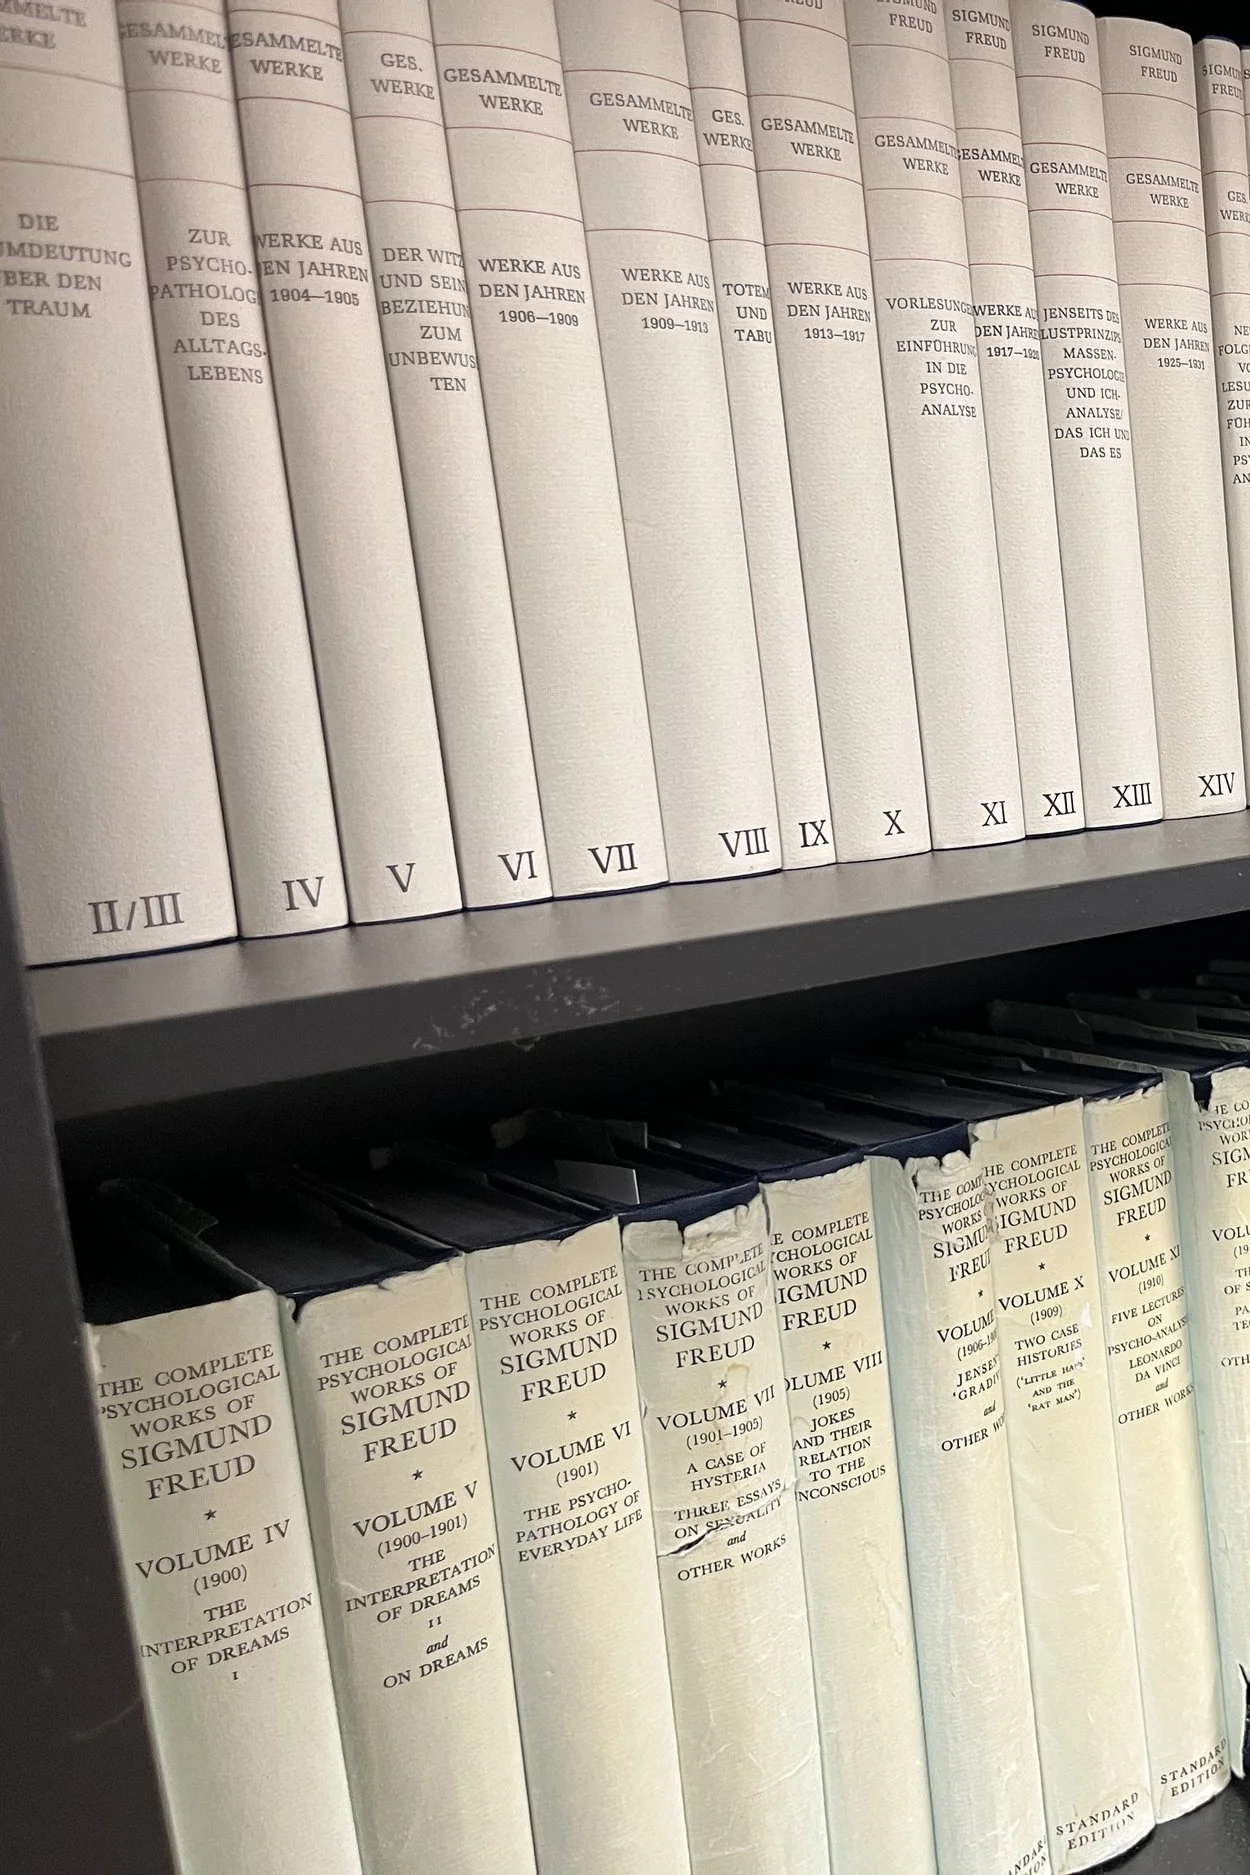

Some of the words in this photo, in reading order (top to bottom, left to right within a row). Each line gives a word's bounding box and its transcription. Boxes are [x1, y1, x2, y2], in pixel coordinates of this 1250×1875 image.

[889, 13, 933, 34] FREUD
[1032, 24, 1090, 46] SIGMUND
[148, 49, 223, 75] WERKE
[381, 53, 423, 72] GES.
[1044, 45, 1086, 64] FREUD
[1129, 45, 1182, 65] SIGMUND
[444, 68, 562, 96] GESAMMELTE
[1141, 66, 1178, 83] FREUD
[479, 94, 543, 116] WERKE
[590, 92, 693, 122] GESAMMELTE
[712, 109, 744, 126] GES.
[622, 118, 679, 140] WERKE
[761, 118, 854, 144] GESAMMELTE
[791, 142, 842, 162] WERKE
[1126, 173, 1199, 194] GESAMMELTE
[1150, 193, 1189, 209] WERKE
[18, 213, 59, 232] DIE
[188, 228, 231, 247] ZUR
[254, 233, 324, 251] WERKE
[330, 236, 364, 256] AUS
[166, 255, 253, 277] PSYCHO-
[383, 247, 424, 264] DER
[478, 258, 545, 275] WERKE
[552, 262, 581, 279] AUS
[723, 283, 770, 300] TOTEM
[9, 299, 91, 319] TRAUM
[200, 310, 241, 329] DES
[736, 306, 767, 320] UND
[1043, 307, 1104, 322] JENSEITS
[1106, 310, 1120, 324] DES
[420, 326, 462, 342] ZUM
[734, 329, 772, 343] TABU
[930, 319, 957, 332] ZUR
[1063, 347, 1117, 361] MASSEN-
[187, 365, 264, 385] LEBENS
[430, 376, 467, 392] TEN
[920, 383, 973, 397] PSYCHO-
[921, 404, 977, 418] ANALYSE
[1080, 447, 1106, 458] DAS
[1110, 448, 1121, 459] ES
[1112, 782, 1152, 809] XIII
[1199, 772, 1235, 798] XIV
[981, 801, 1008, 827] XI
[1043, 791, 1077, 817] XII
[799, 820, 829, 848] IX
[883, 810, 905, 836] X
[719, 827, 769, 857] VIII
[498, 851, 539, 881] VI
[588, 842, 639, 875] VII
[386, 862, 416, 894] V
[281, 876, 324, 911] IV
[89, 892, 184, 935] II/III
[1116, 1196, 1167, 1227] FREUD
[998, 1282, 1070, 1311] VOLUME
[1074, 1275, 1086, 1289] X
[479, 1282, 623, 1332] PSYCHOLOGICAL
[1030, 1305, 1063, 1326] (1909)
[655, 1301, 764, 1344] SIGMUND
[320, 1347, 363, 1369] THE
[373, 1314, 470, 1356] COMPLETE
[1129, 1339, 1183, 1369] LEONARDO
[100, 1377, 143, 1398] THE
[155, 1343, 275, 1387] COMPLETE
[1135, 1371, 1151, 1383] DA
[1154, 1356, 1181, 1376] VINCI
[810, 1408, 855, 1433] JOKES
[121, 1413, 273, 1471] SIGMUND
[510, 1432, 606, 1473] VOLUME
[612, 1420, 632, 1441] VI
[792, 1435, 825, 1450] AND
[829, 1419, 872, 1442] THEIR
[686, 1463, 698, 1475] A
[705, 1451, 744, 1472] CASE
[749, 1441, 768, 1457] OF
[799, 1436, 872, 1467] RELATION
[146, 1453, 256, 1500] FREUD
[555, 1460, 599, 1488] (1901)
[690, 1462, 767, 1492] HYSTERIA
[353, 1492, 457, 1538] VOLUME
[464, 1480, 480, 1500] V
[523, 1502, 561, 1522] THE
[568, 1478, 632, 1511] PSYCHO-
[515, 1501, 619, 1544] PATHOLOGY
[624, 1489, 641, 1507] OF
[135, 1533, 254, 1579] VOLUME
[264, 1518, 291, 1545] IV
[518, 1526, 609, 1563] EVERYDAY
[615, 1508, 643, 1534] LIFE
[677, 1558, 735, 1582] OTHER
[740, 1534, 787, 1564] WORKS
[193, 1563, 249, 1597] (1900)
[345, 1543, 496, 1612] INTERPRETATION
[171, 1656, 198, 1675] OF
[208, 1626, 290, 1667] DREAMS
[426, 1634, 450, 1655] and
[382, 1670, 411, 1689] ON
[419, 1637, 489, 1678] DREAMS
[1056, 1792, 1140, 1836] STANDARD
[1068, 1811, 1136, 1851] EDITION
